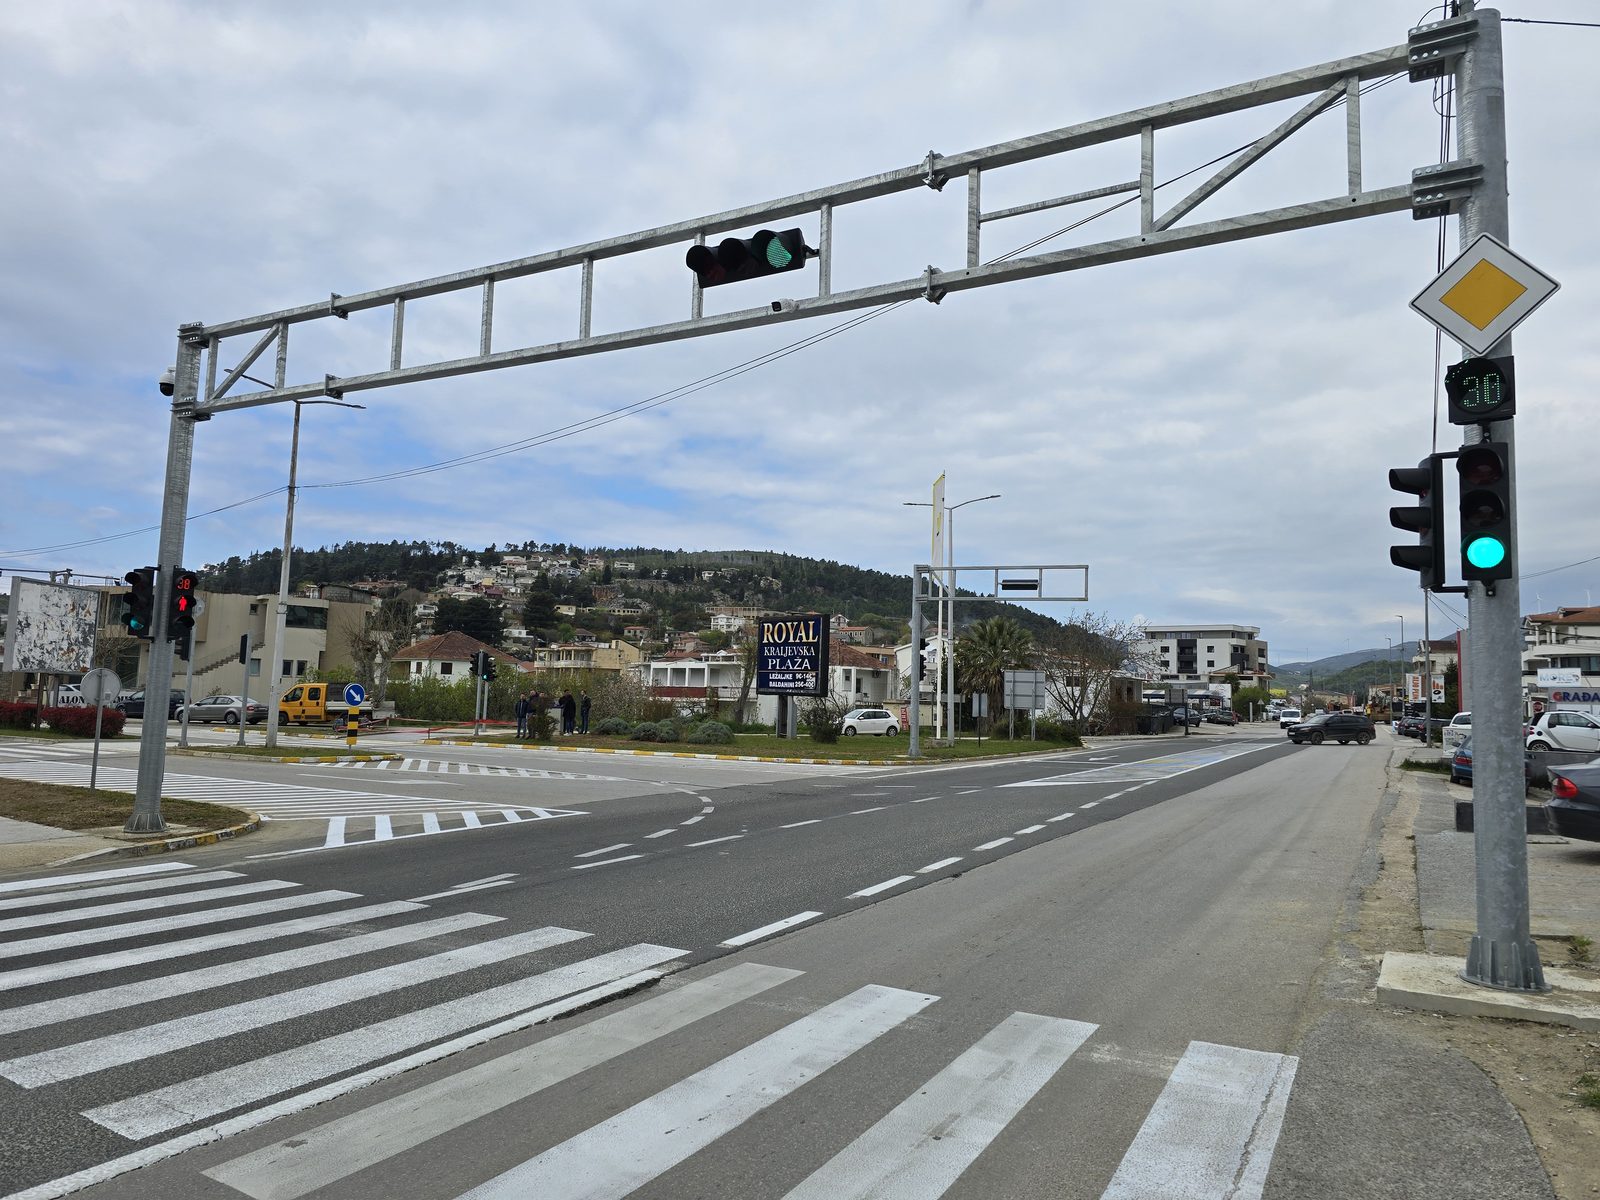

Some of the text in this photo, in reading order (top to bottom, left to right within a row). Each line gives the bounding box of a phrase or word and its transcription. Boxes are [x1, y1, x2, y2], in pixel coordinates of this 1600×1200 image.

[762, 620, 819, 644] ROYAL
[764, 645, 816, 657] KRALJEVSKA
[767, 656, 811, 670] PLAŽA
[58, 695, 85, 704] ALON
[1552, 691, 1600, 703] GRAĐA
